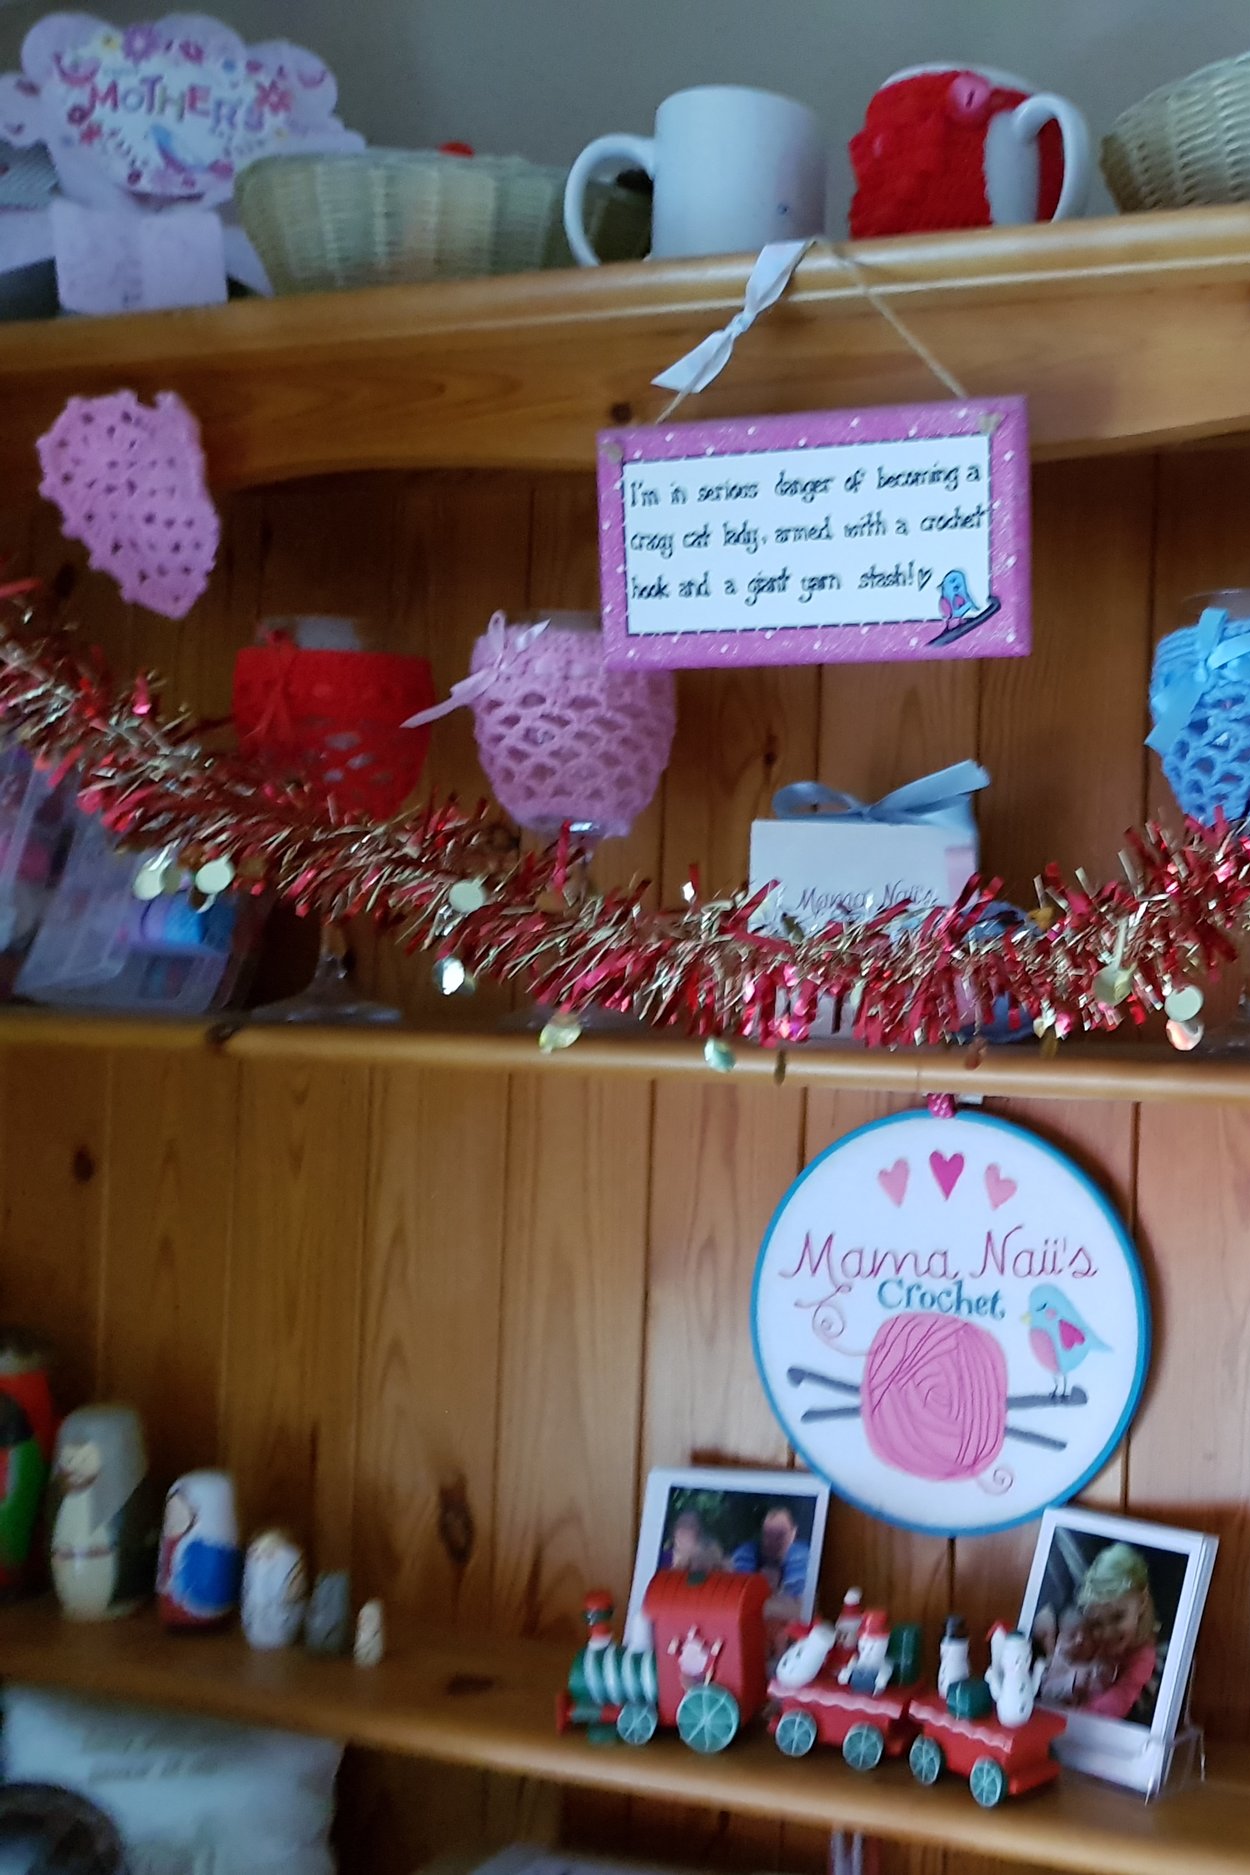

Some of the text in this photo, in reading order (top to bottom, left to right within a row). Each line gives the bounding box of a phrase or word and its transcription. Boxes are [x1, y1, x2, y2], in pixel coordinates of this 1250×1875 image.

[631, 461, 981, 507] I'm in serious danger of becoming a
[630, 531, 674, 559] crazy
[682, 522, 711, 548] cat
[774, 514, 834, 543] armed
[844, 510, 887, 538] with
[895, 517, 909, 536] a
[920, 503, 990, 532] crochet
[631, 559, 915, 606] hook and a giant yarn stash!
[779, 1229, 959, 1281] Mama
[877, 1279, 1006, 1320] Crochet
